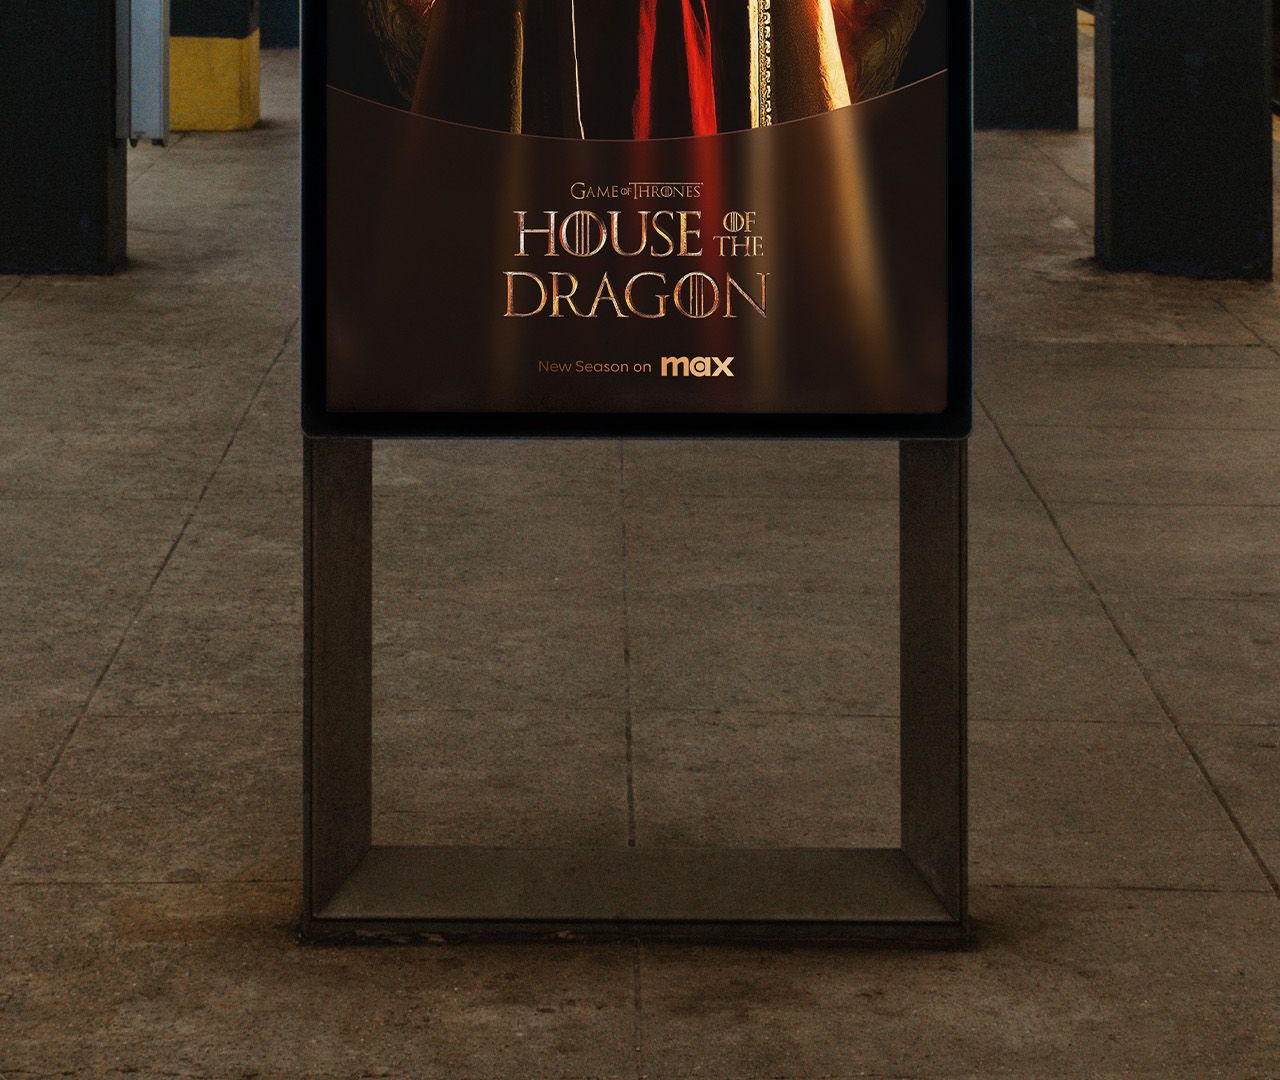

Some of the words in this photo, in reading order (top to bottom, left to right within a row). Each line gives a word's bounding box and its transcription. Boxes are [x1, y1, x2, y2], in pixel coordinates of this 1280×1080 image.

[570, 182, 619, 199] GAME
[629, 182, 703, 199] THRONES
[722, 211, 756, 233] OF
[513, 210, 703, 257] HOUSE
[713, 235, 765, 257] THE
[502, 271, 771, 318] DRAGON
[538, 360, 572, 373] New
[575, 360, 629, 374] Season
[633, 363, 652, 373] on
[660, 355, 735, 377] max
